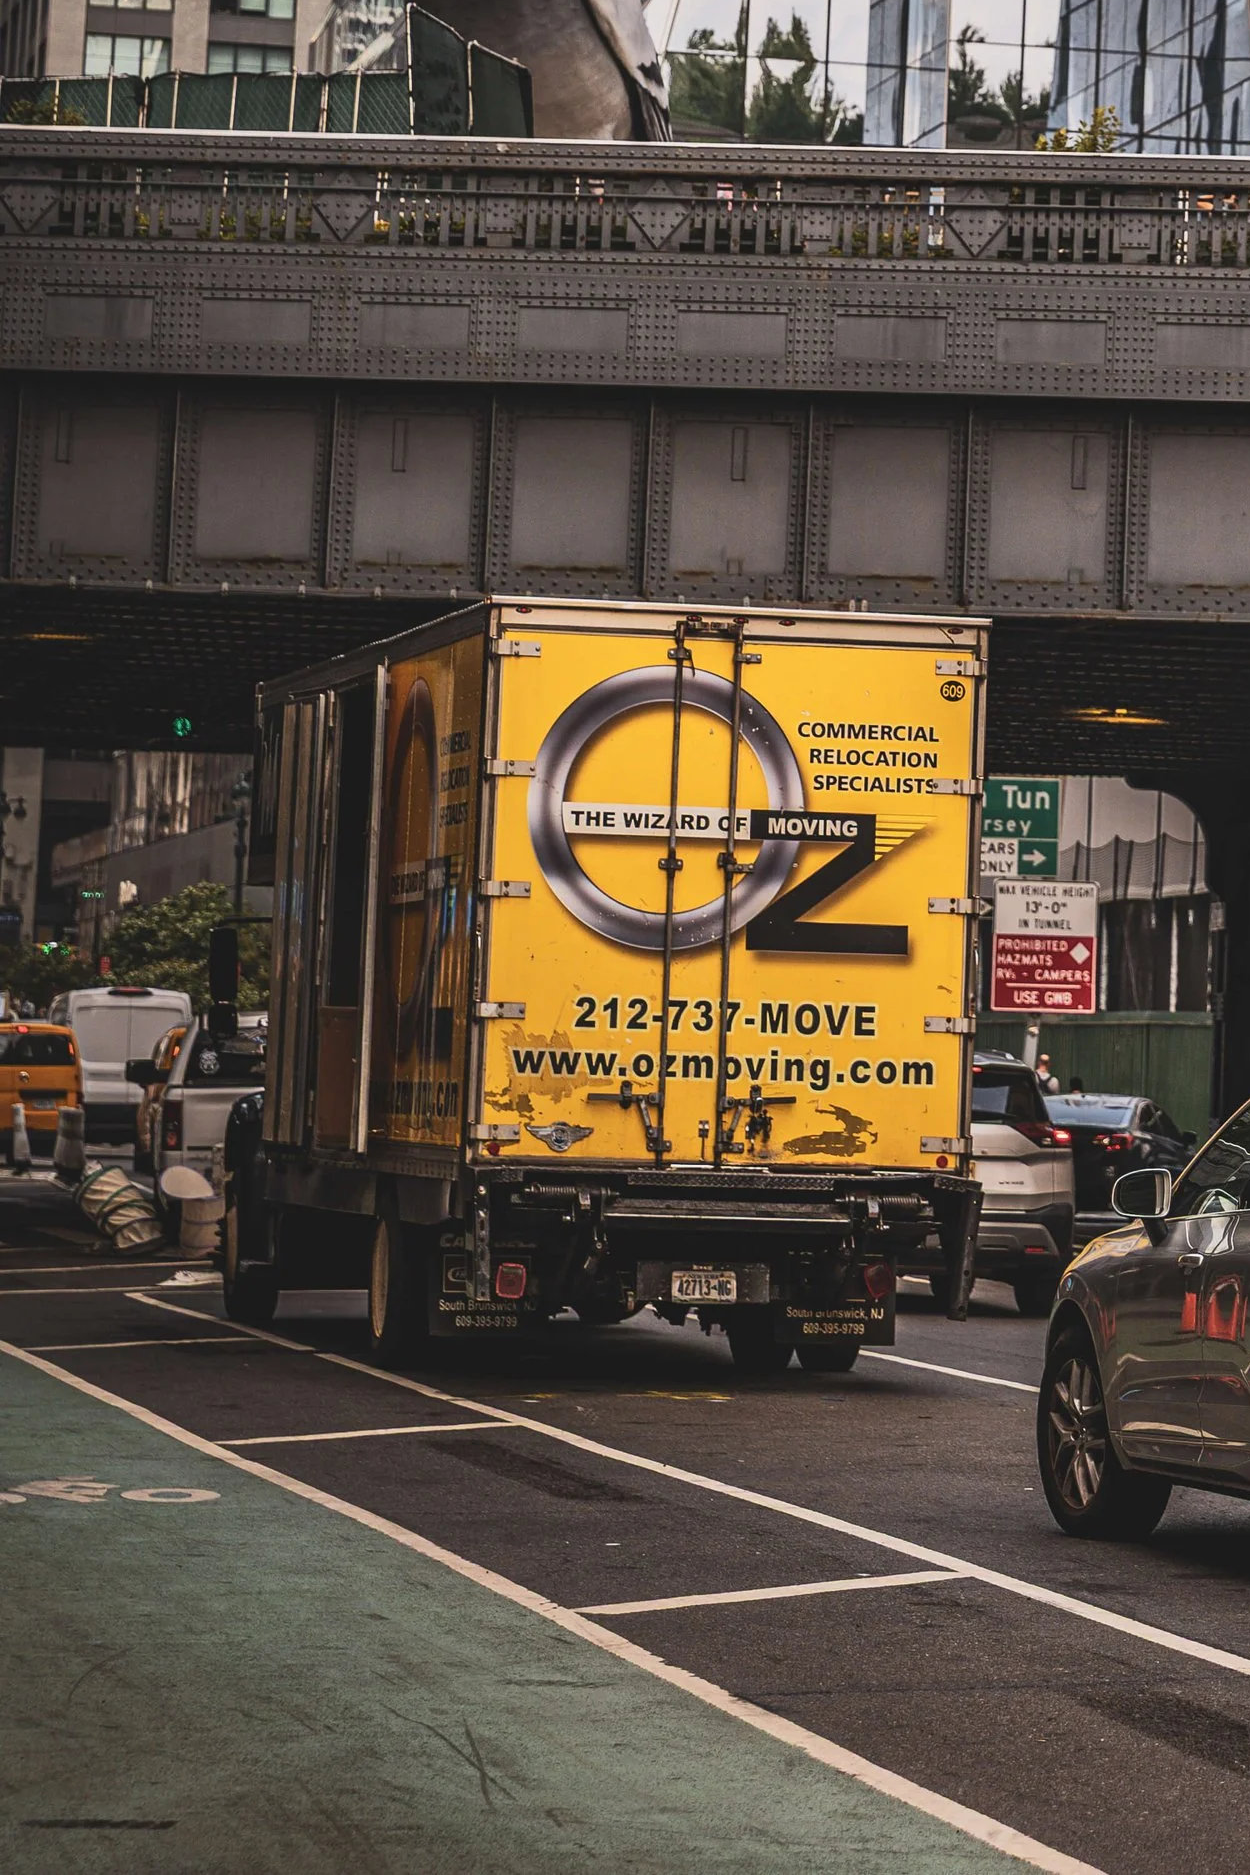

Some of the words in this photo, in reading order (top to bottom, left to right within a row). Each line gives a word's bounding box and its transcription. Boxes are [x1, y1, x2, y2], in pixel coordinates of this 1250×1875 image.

[940, 683, 964, 699] 609
[797, 721, 940, 743] COMMERCIAL
[808, 747, 939, 769] RELOCATION
[812, 774, 935, 795] SPECIALISTS
[1001, 785, 1050, 810] Tun
[570, 810, 616, 829] THE
[622, 811, 710, 832] WIZARD
[717, 815, 748, 833] OF
[767, 816, 858, 837] MOVING
[983, 818, 1032, 837] rsey
[980, 841, 1016, 855] CARS
[980, 860, 1014, 873] ONLY
[1020, 885, 1057, 897] VEHICLE
[1018, 919, 1029, 928] IN
[1034, 918, 1072, 930] TUNNEL
[997, 938, 1068, 952] PROHIBITED
[996, 953, 1053, 966] HAZMATS
[1034, 969, 1091, 982] CAMPERS
[1013, 990, 1040, 1005] USE
[1044, 991, 1073, 1006] GWB
[574, 996, 877, 1037] 212-737-MOVE
[512, 1047, 936, 1091] www.ozmoving.com
[438, 1299, 465, 1311] South
[870, 1307, 885, 1320] NJ
[802, 1322, 865, 1335] 609-395-9799
